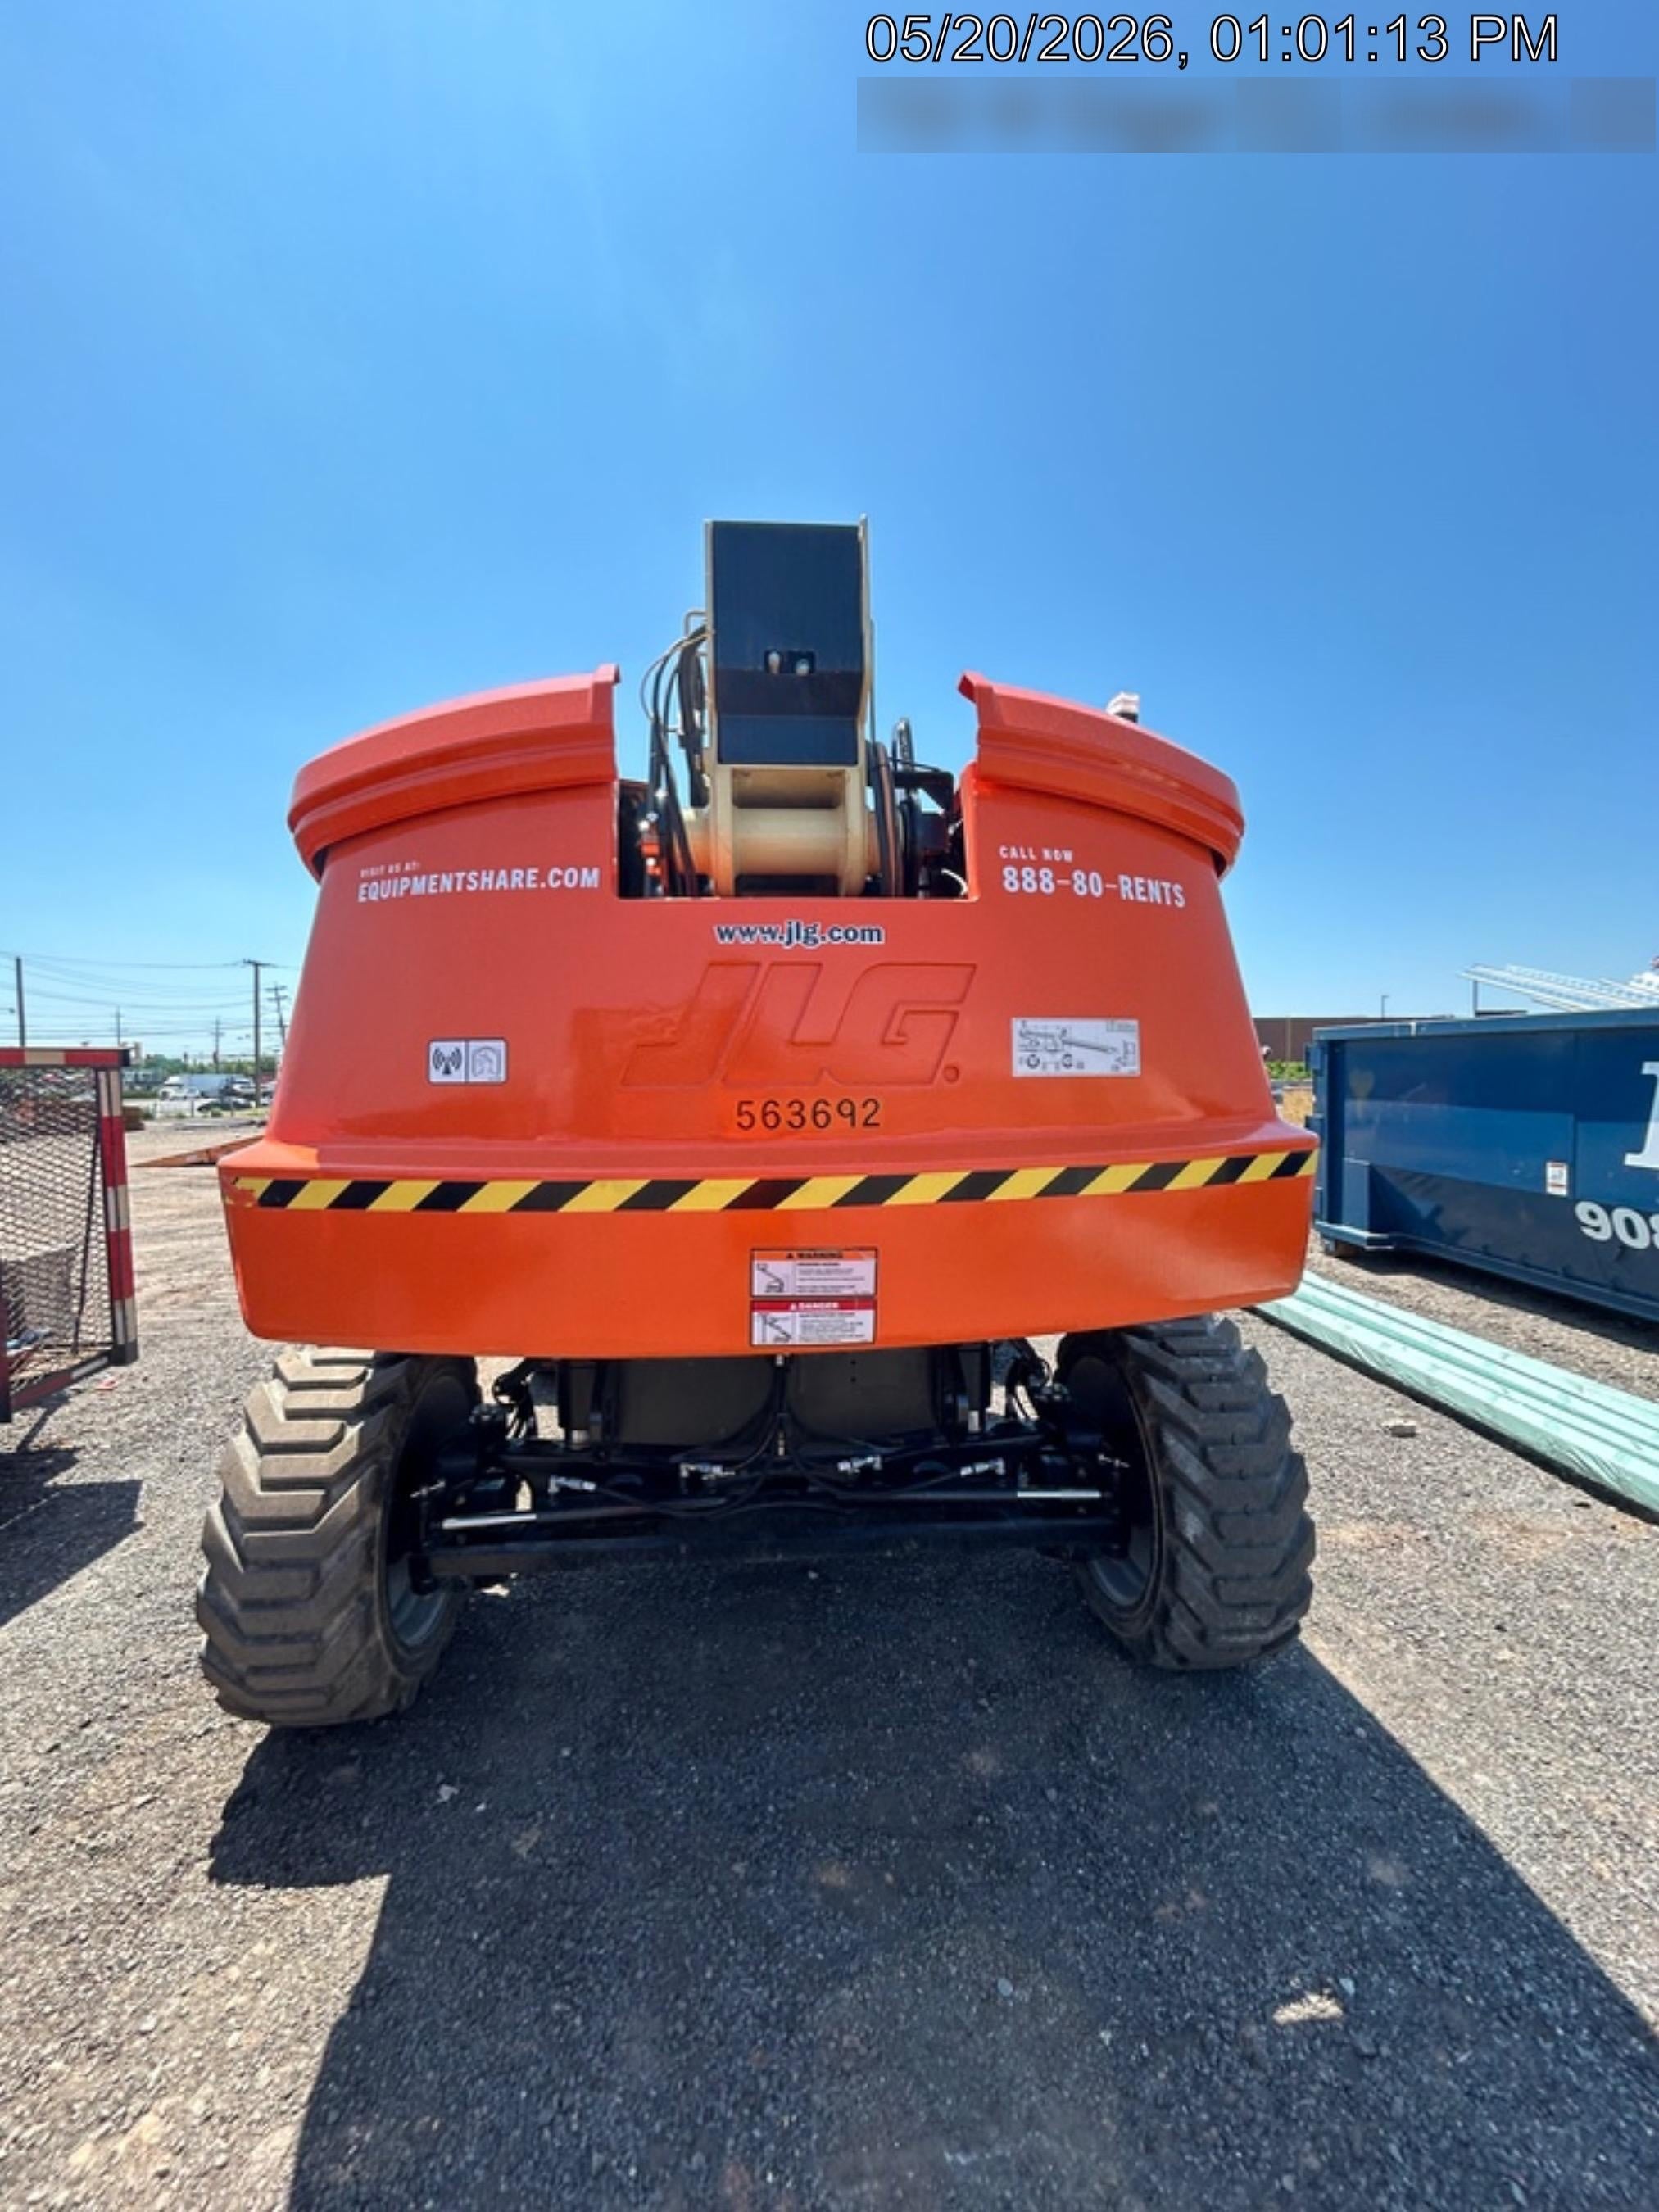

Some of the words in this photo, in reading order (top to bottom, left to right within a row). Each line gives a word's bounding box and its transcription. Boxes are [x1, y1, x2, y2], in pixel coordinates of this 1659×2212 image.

[999, 845, 1036, 860] CALL
[1042, 848, 1073, 862] NOW
[357, 867, 600, 903] EQUIPMENTSHARE.COM
[1002, 865, 1185, 908] 888-80-RENTS
[715, 920, 886, 948] www.jlg.com
[737, 1098, 882, 1131] 563692
[1575, 1200, 1659, 1250] 90
